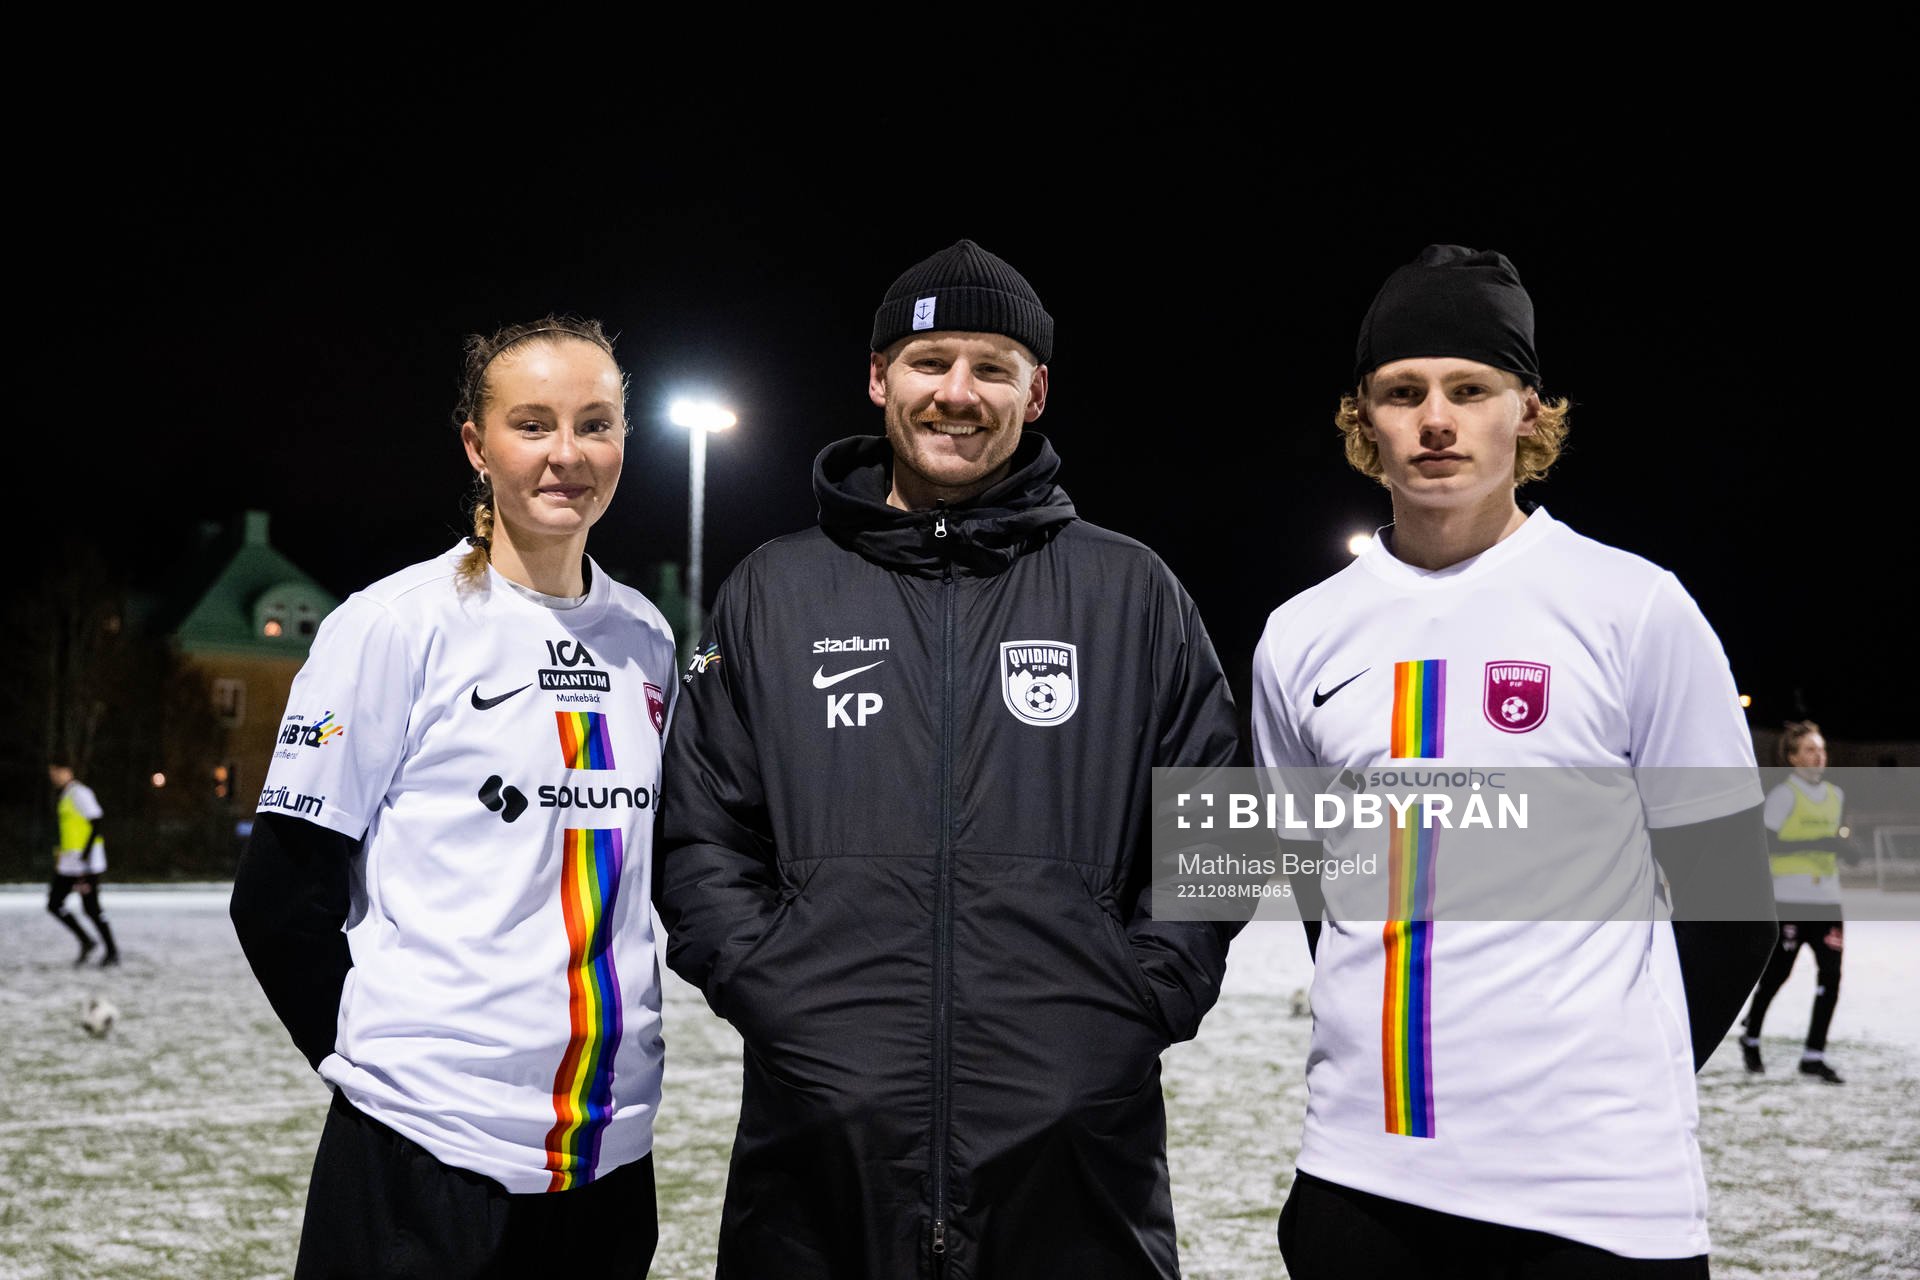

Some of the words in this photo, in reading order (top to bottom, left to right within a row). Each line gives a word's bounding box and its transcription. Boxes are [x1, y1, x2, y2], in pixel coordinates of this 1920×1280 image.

[545, 640, 596, 667] ICA
[813, 636, 889, 654] stadium
[1008, 648, 1068, 668] QVIDING
[542, 672, 608, 689] KVANTUM
[1491, 667, 1543, 684] QVIDING
[827, 693, 883, 728] KP
